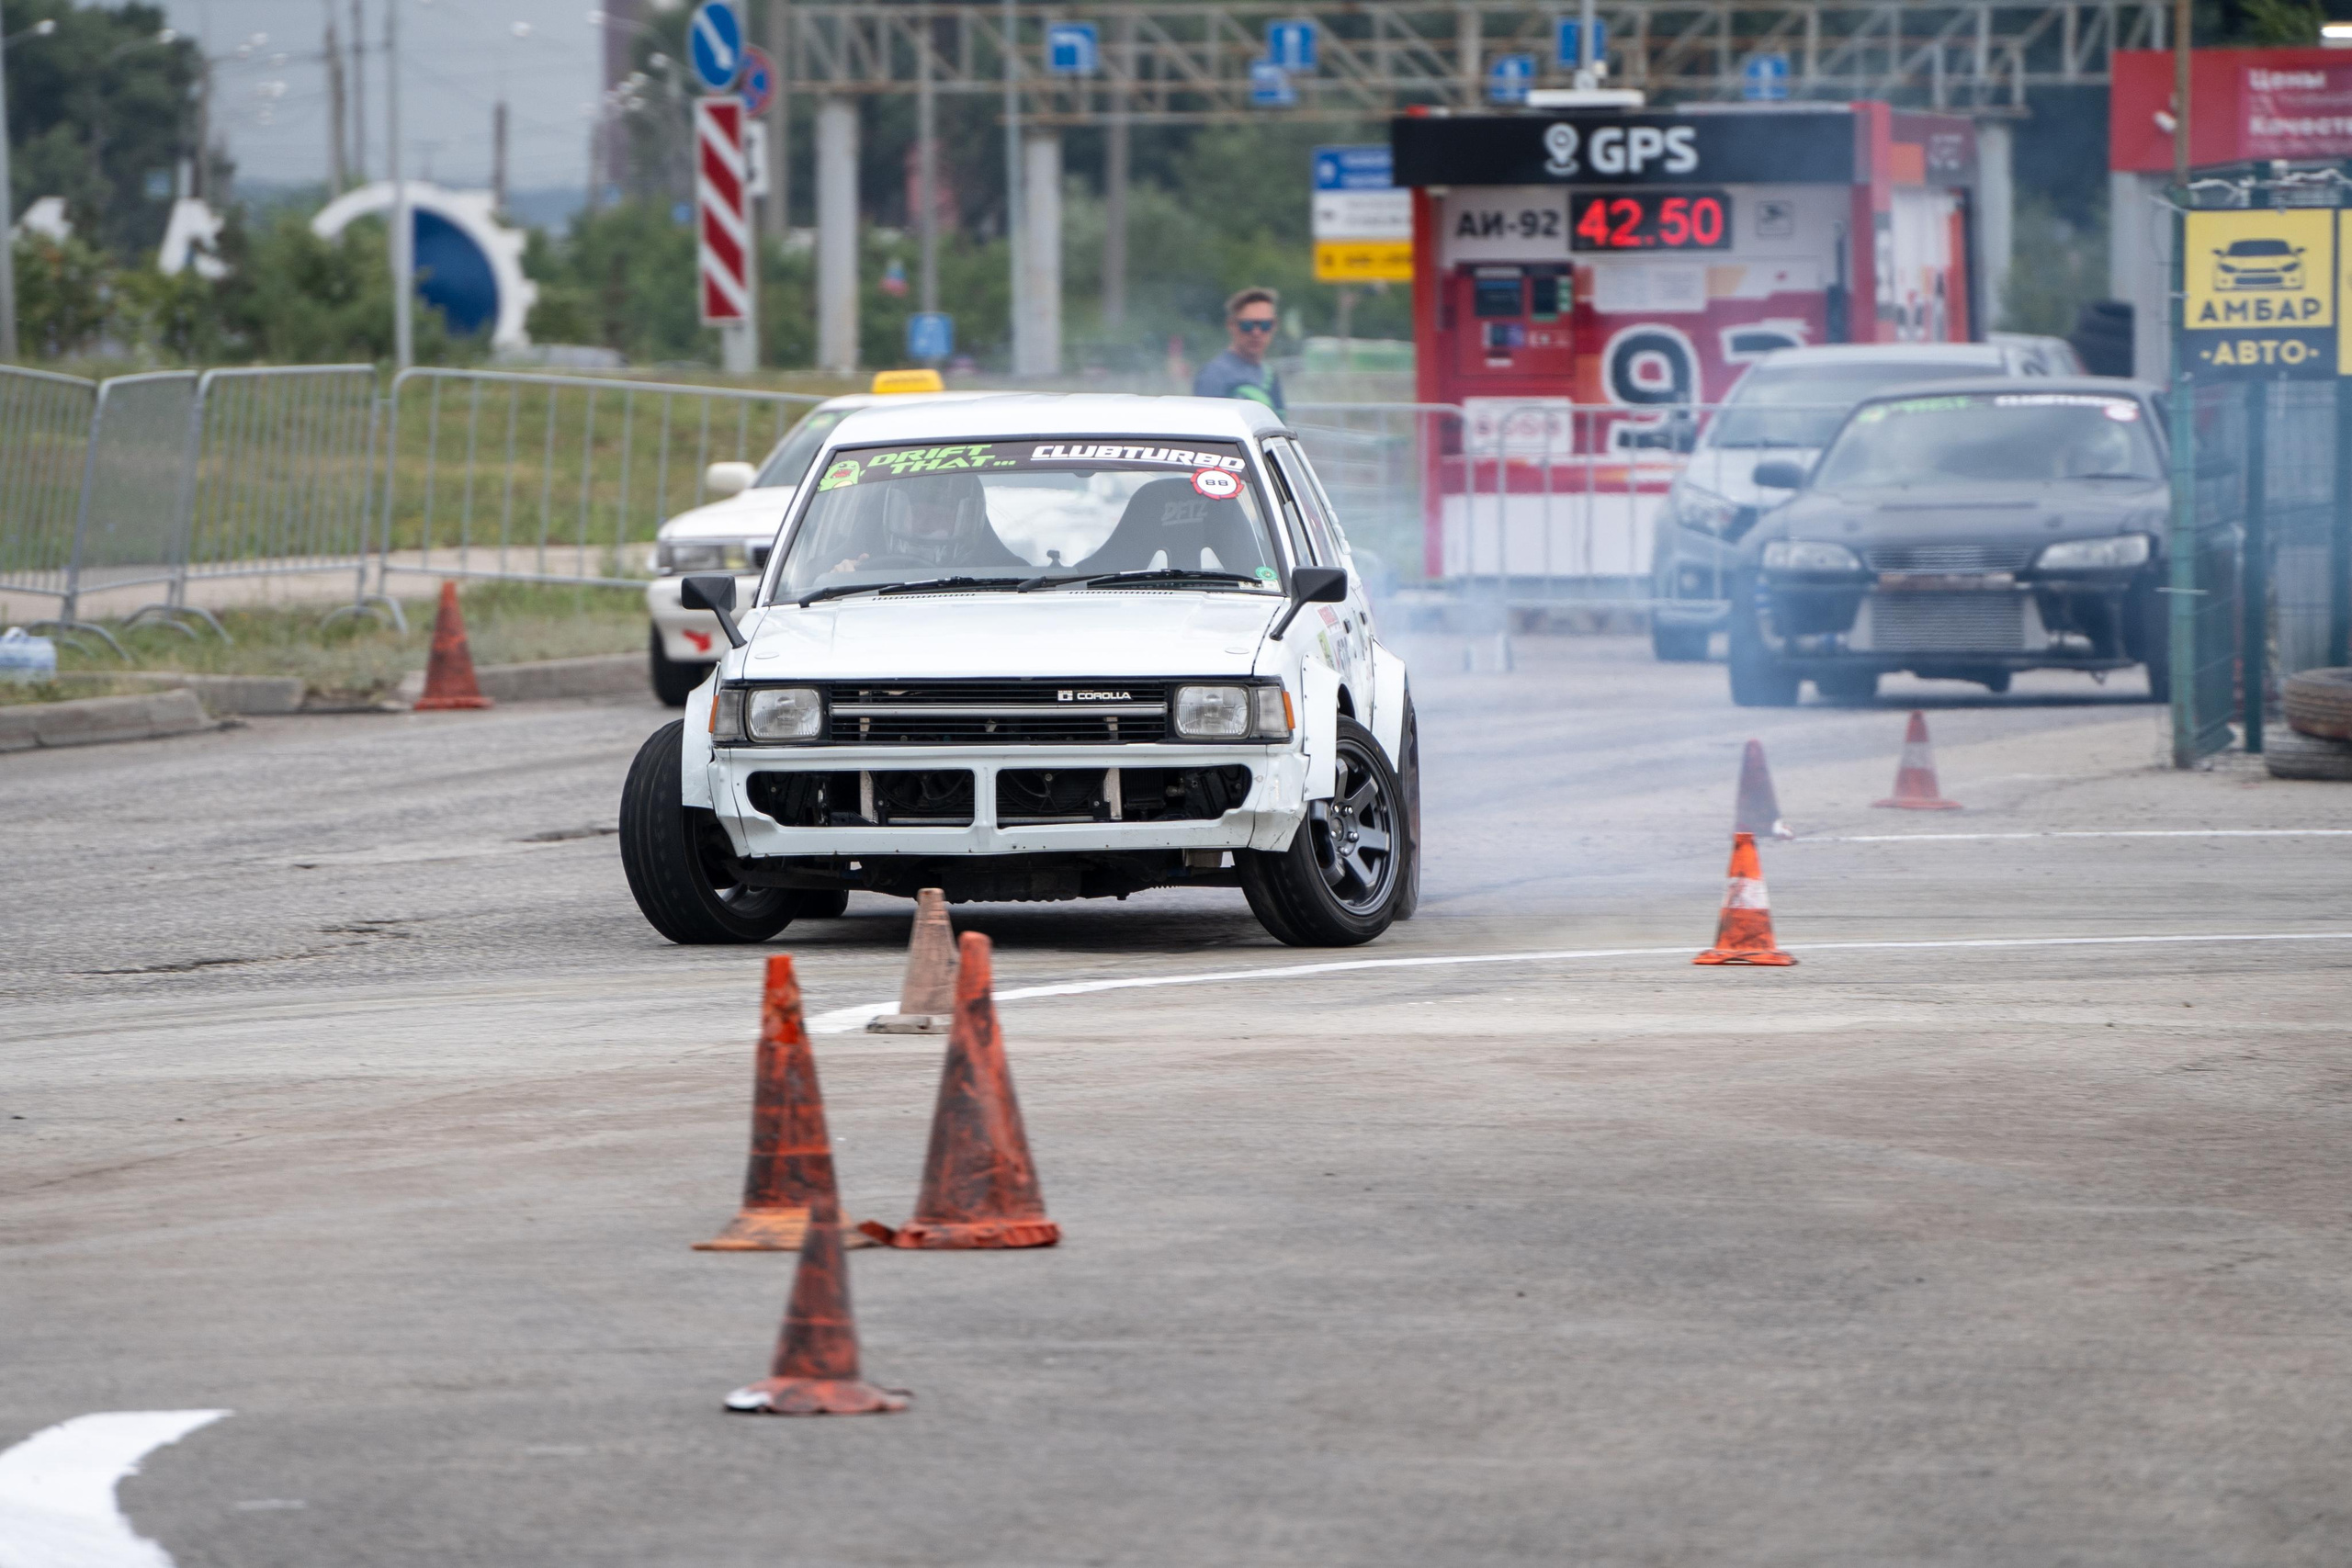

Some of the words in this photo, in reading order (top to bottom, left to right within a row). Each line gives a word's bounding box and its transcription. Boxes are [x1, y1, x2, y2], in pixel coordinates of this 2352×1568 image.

[1588, 125, 1700, 175] GPS
[1456, 209, 1561, 239] АИ-92
[1576, 197, 1724, 247] 42.50
[2198, 298, 2322, 322] АМБАР
[866, 445, 992, 468] DRIFT
[1031, 445, 1246, 470] CLUBTURBO
[1077, 692, 1132, 700] COROLLA
